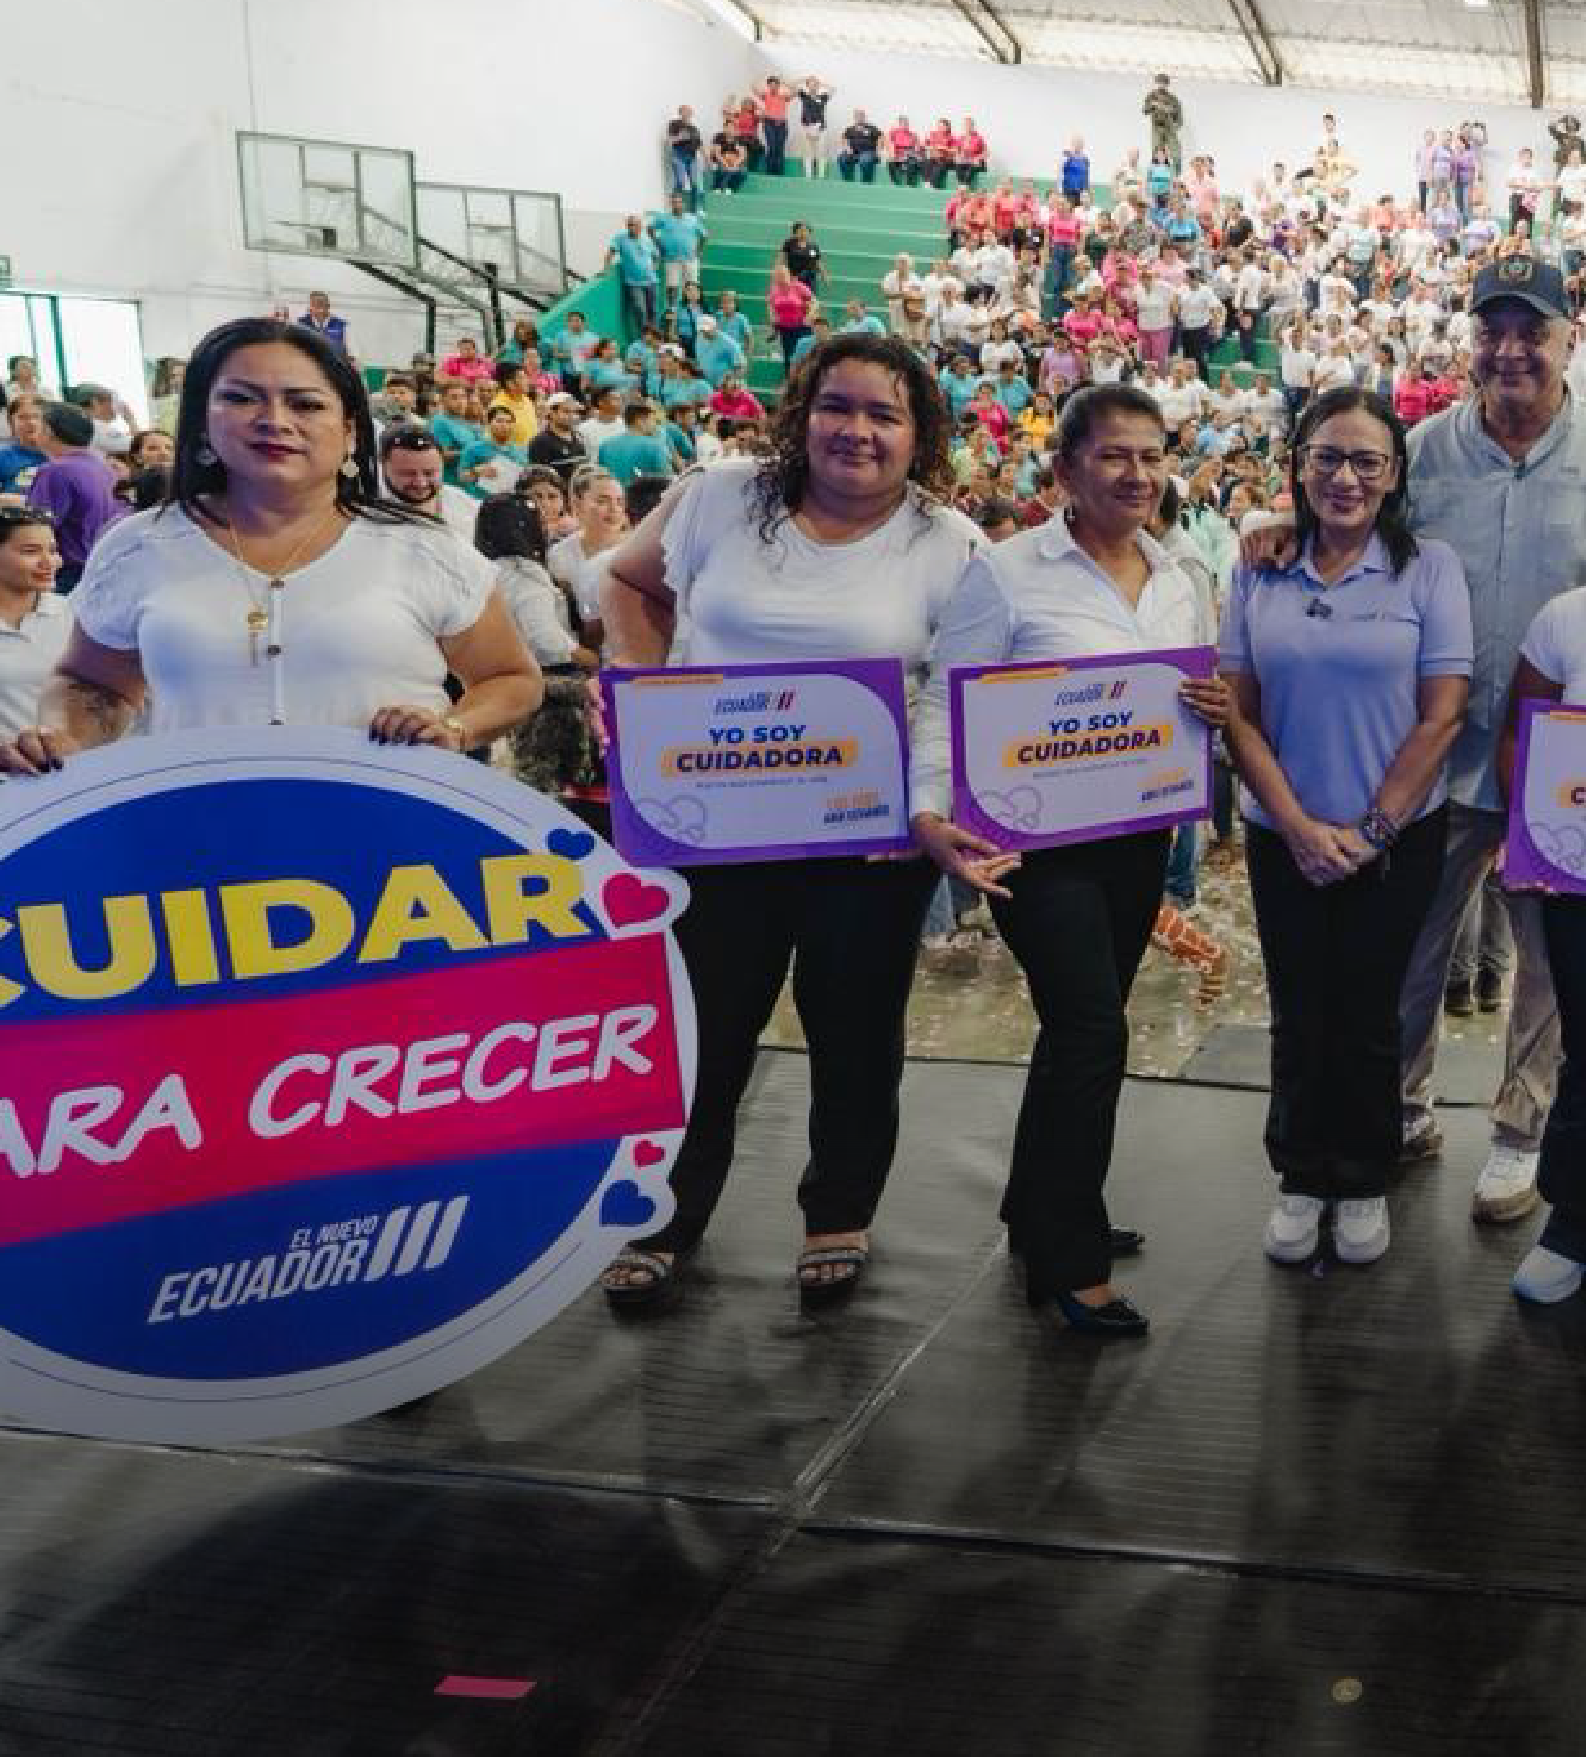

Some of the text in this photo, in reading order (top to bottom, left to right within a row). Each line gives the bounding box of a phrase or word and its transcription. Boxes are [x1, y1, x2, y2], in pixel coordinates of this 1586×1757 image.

[708, 724, 807, 747] YO SOY
[1049, 710, 1134, 737] YO SOY
[676, 746, 844, 773] CUIDADORA
[1016, 728, 1162, 765] CUIDADORA
[0, 854, 592, 1008] UIDAR
[247, 1003, 660, 1139] CRECER
[291, 1215, 380, 1250] EL NUEVO
[147, 1239, 369, 1325] ECUADOR
